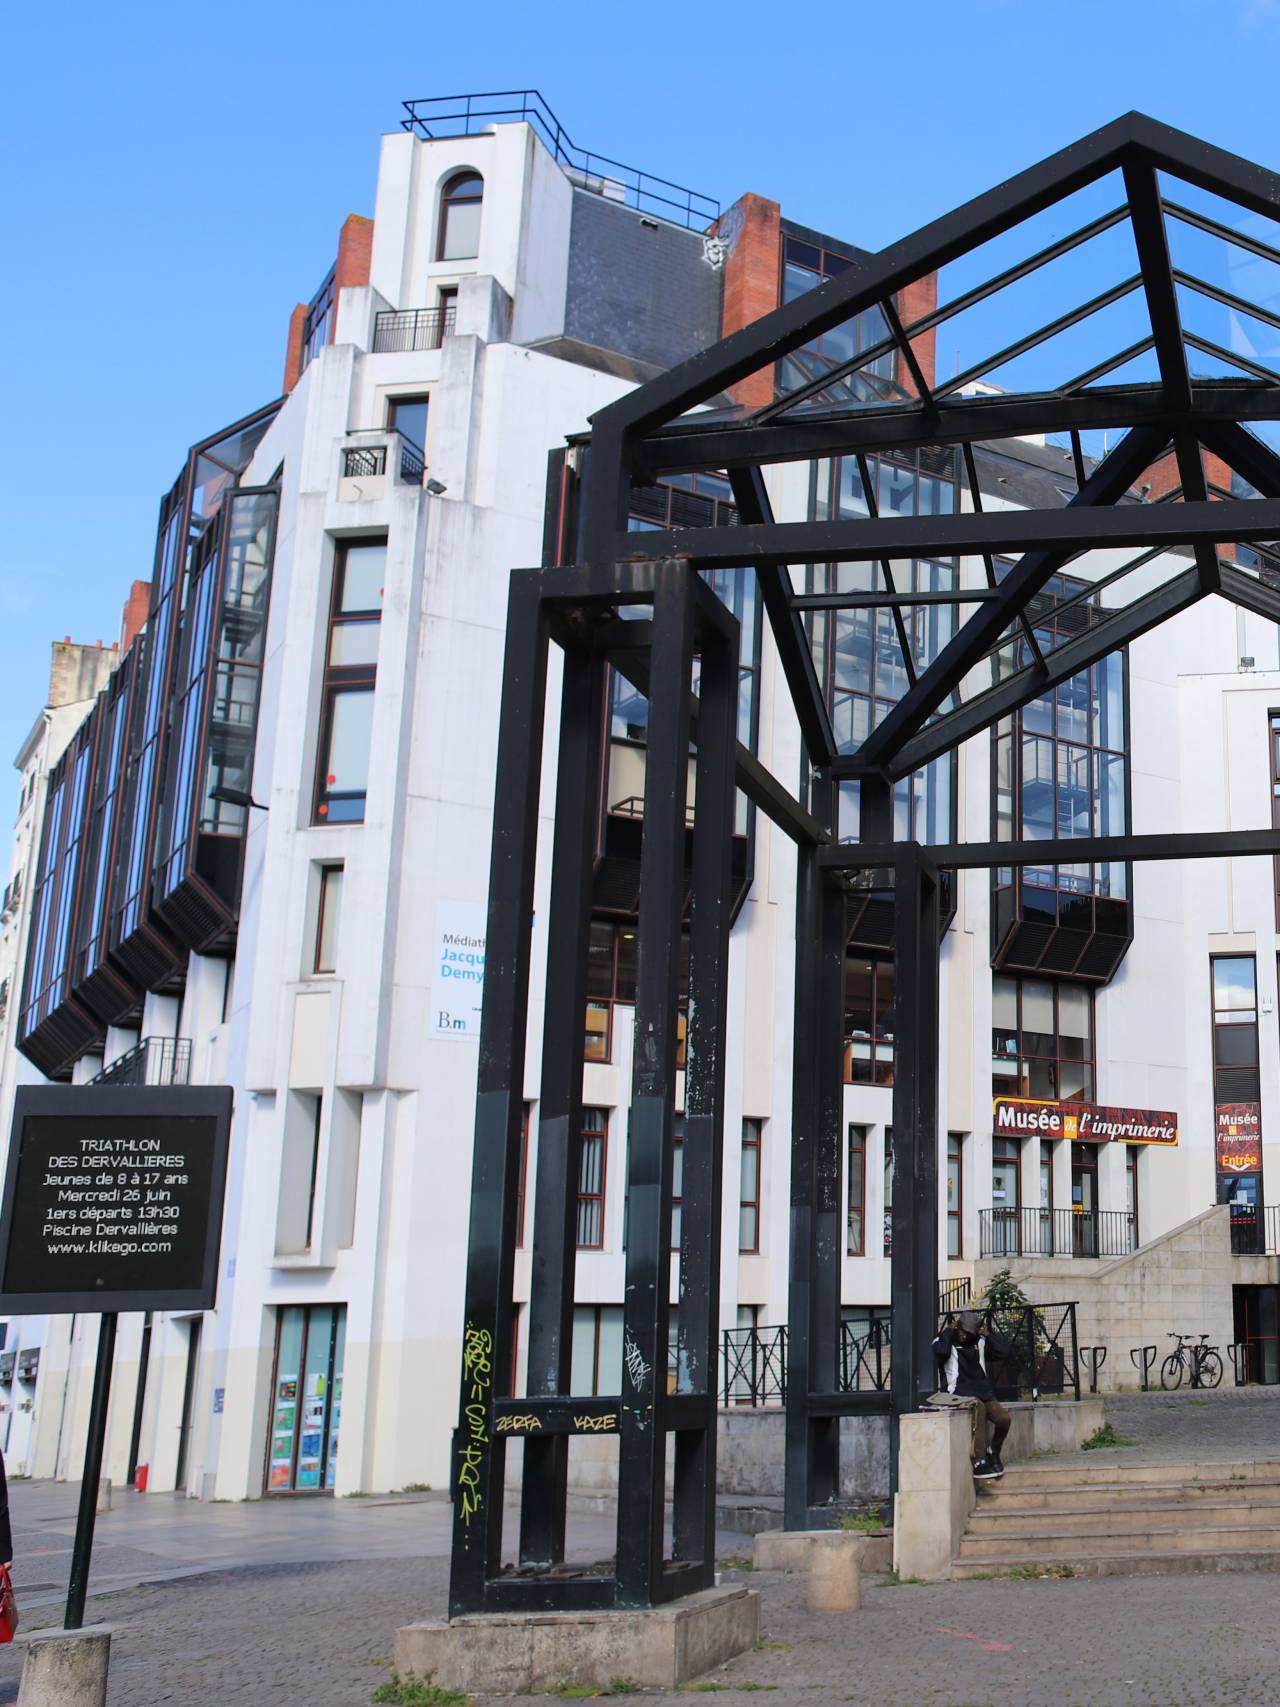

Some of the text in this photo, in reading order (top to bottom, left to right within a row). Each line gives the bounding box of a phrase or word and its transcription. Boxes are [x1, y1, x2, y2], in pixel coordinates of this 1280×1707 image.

[998, 1106, 1060, 1131] Musée
[1064, 1119, 1076, 1131] de
[1219, 1113, 1258, 1125] Musée
[80, 1139, 160, 1151] TRIATHLON
[48, 1155, 185, 1168] DES DERVALLIERES
[1222, 1153, 1257, 1166] Entrée
[42, 1172, 189, 1186] Jeunes de 8 à 17 ans
[58, 1188, 170, 1204] Mercredi 26 juin
[46, 1206, 180, 1221] 1ers départs 13h30
[43, 1222, 178, 1237] Piscine Dervallières
[48, 1241, 171, 1255] www.klikego.com
[573, 1414, 617, 1431] KAZE
